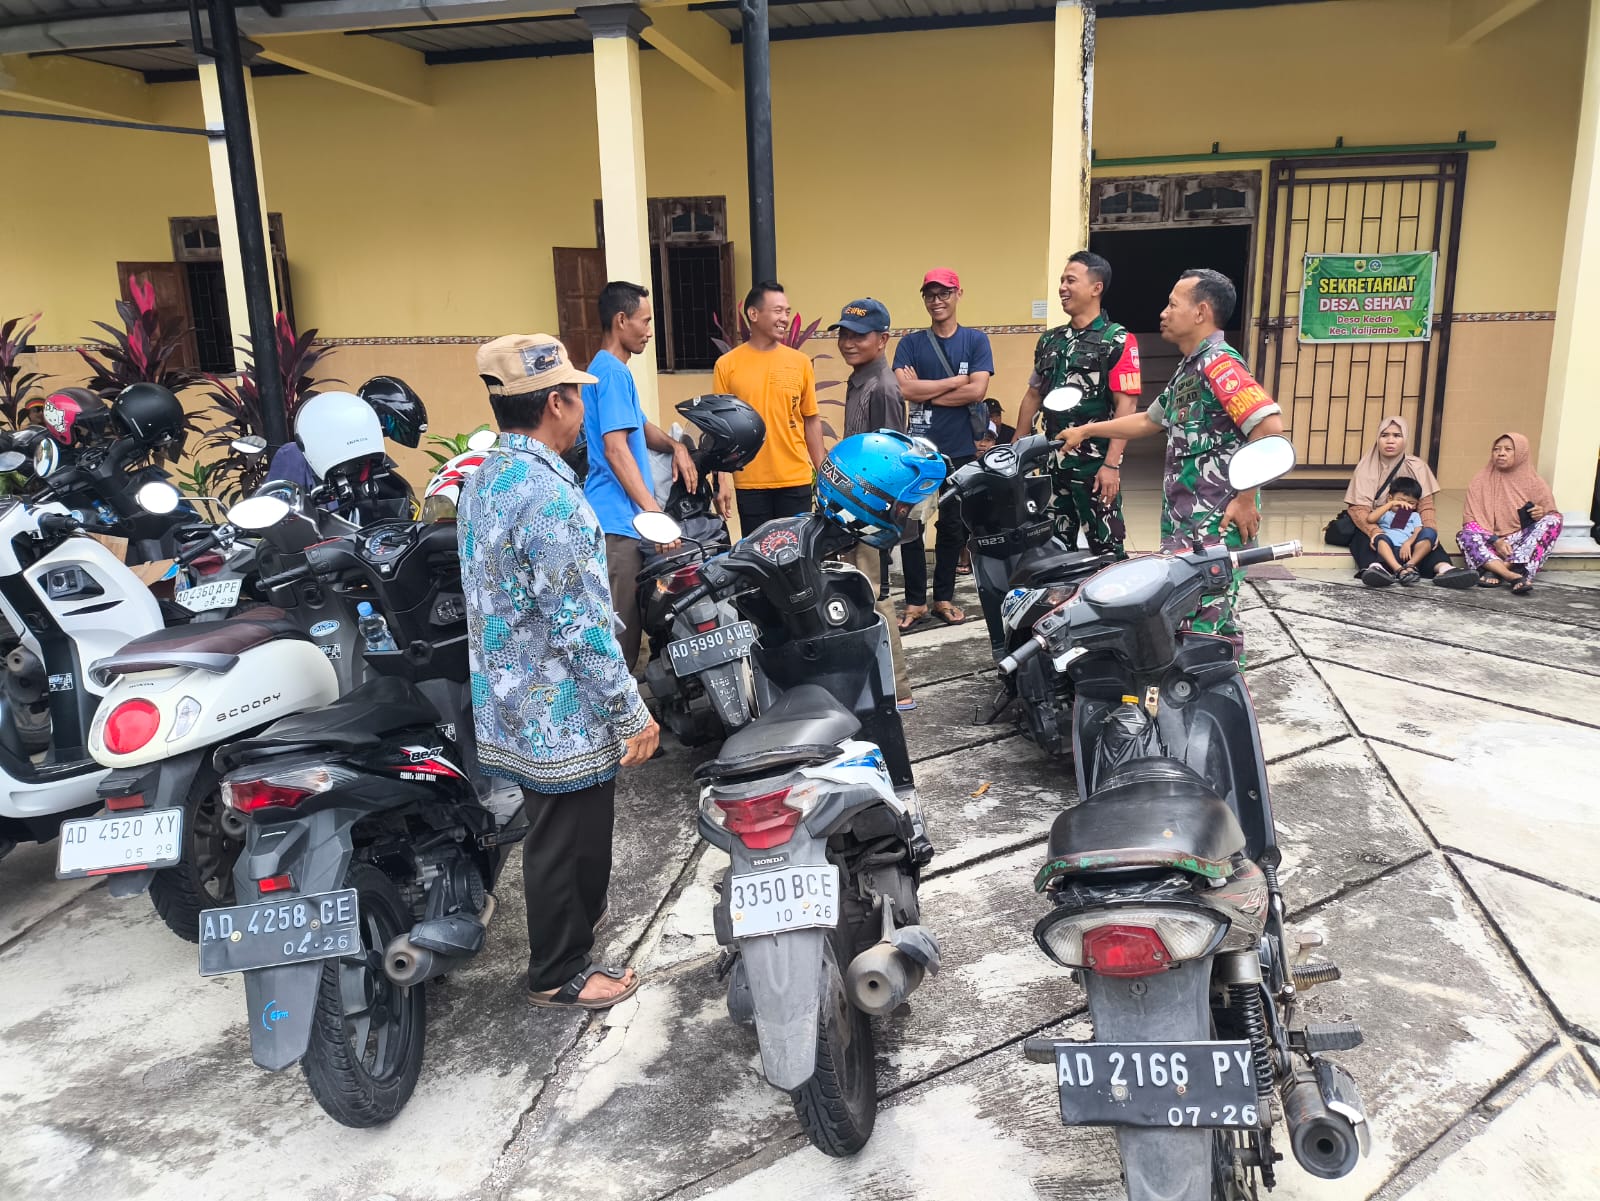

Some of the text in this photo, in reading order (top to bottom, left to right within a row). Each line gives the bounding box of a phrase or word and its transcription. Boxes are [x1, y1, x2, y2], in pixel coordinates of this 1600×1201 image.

[1319, 276, 1416, 294] SEKRETARIAT
[1319, 296, 1413, 311] DESA SEHAT
[1337, 315, 1393, 323] Desa Keden
[1329, 326, 1399, 336] Kec. Kalijambe
[177, 591, 188, 602] AD
[215, 582, 237, 594] APE
[672, 624, 752, 659] AD 5990 AWE
[216, 692, 281, 721] SCOOPY
[65, 815, 175, 845] AD 4520 XY
[125, 843, 173, 859] 05 29
[753, 856, 785, 866] HONDA
[734, 873, 832, 910] 3350 BCE
[203, 897, 351, 941] AD 4258 GE
[1058, 1050, 1251, 1087] AD 2166 PY
